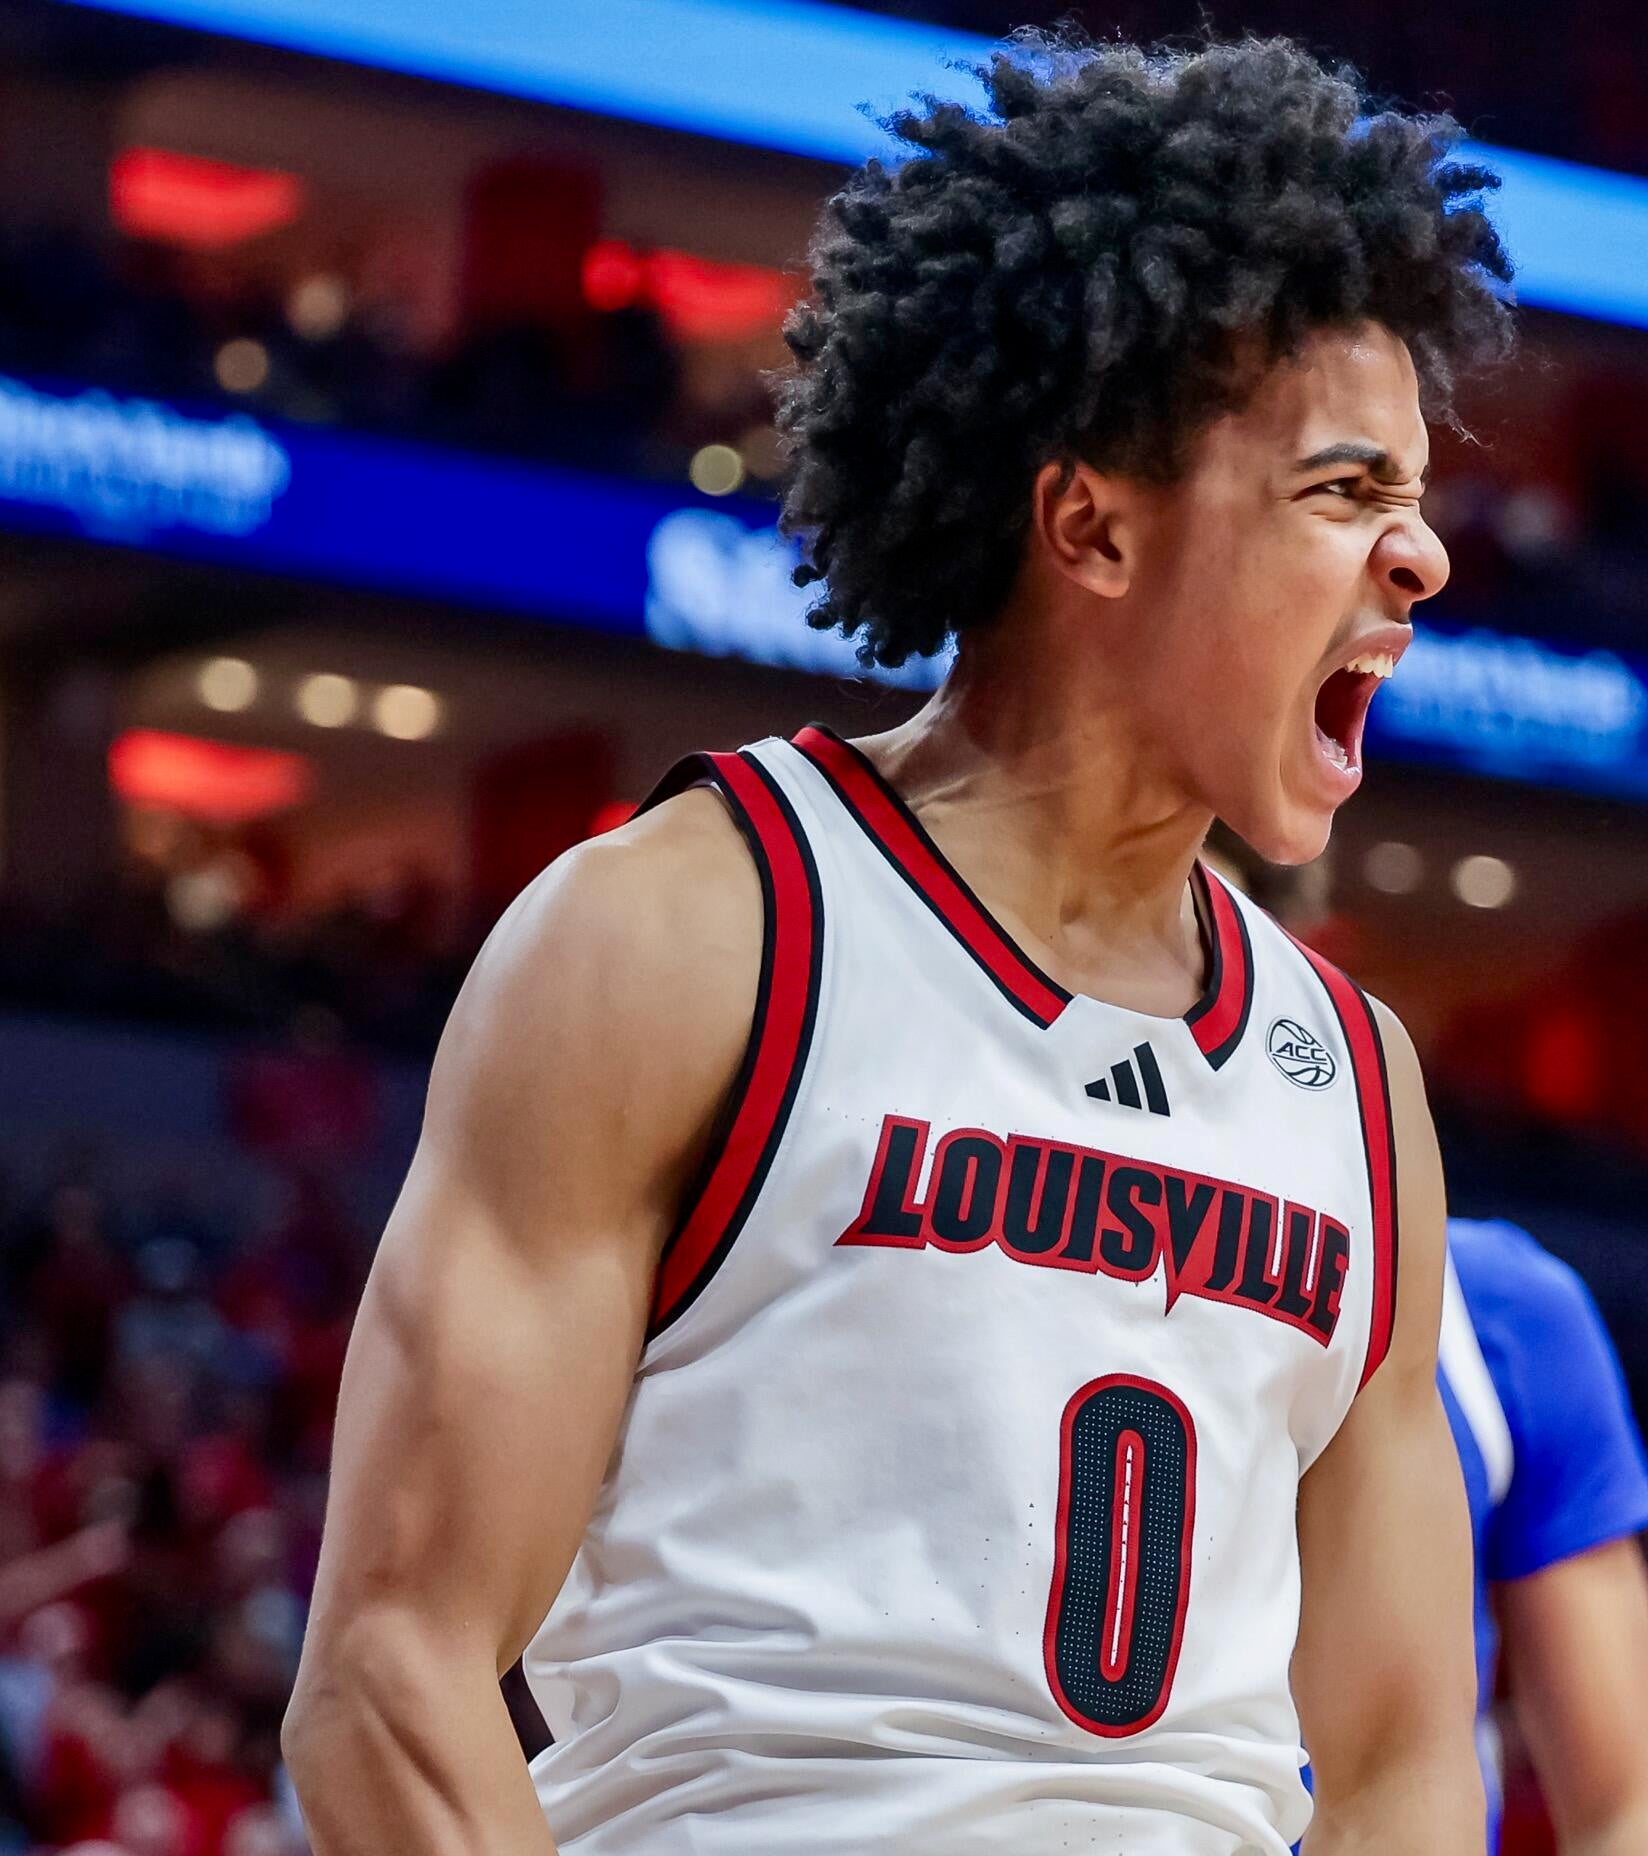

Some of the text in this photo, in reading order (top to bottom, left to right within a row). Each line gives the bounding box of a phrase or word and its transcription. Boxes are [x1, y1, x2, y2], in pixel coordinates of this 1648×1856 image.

[1276, 1041, 1327, 1061] ACC
[834, 1113, 1350, 1348] LOUISVILLE
[1043, 1372, 1198, 1739] 0
